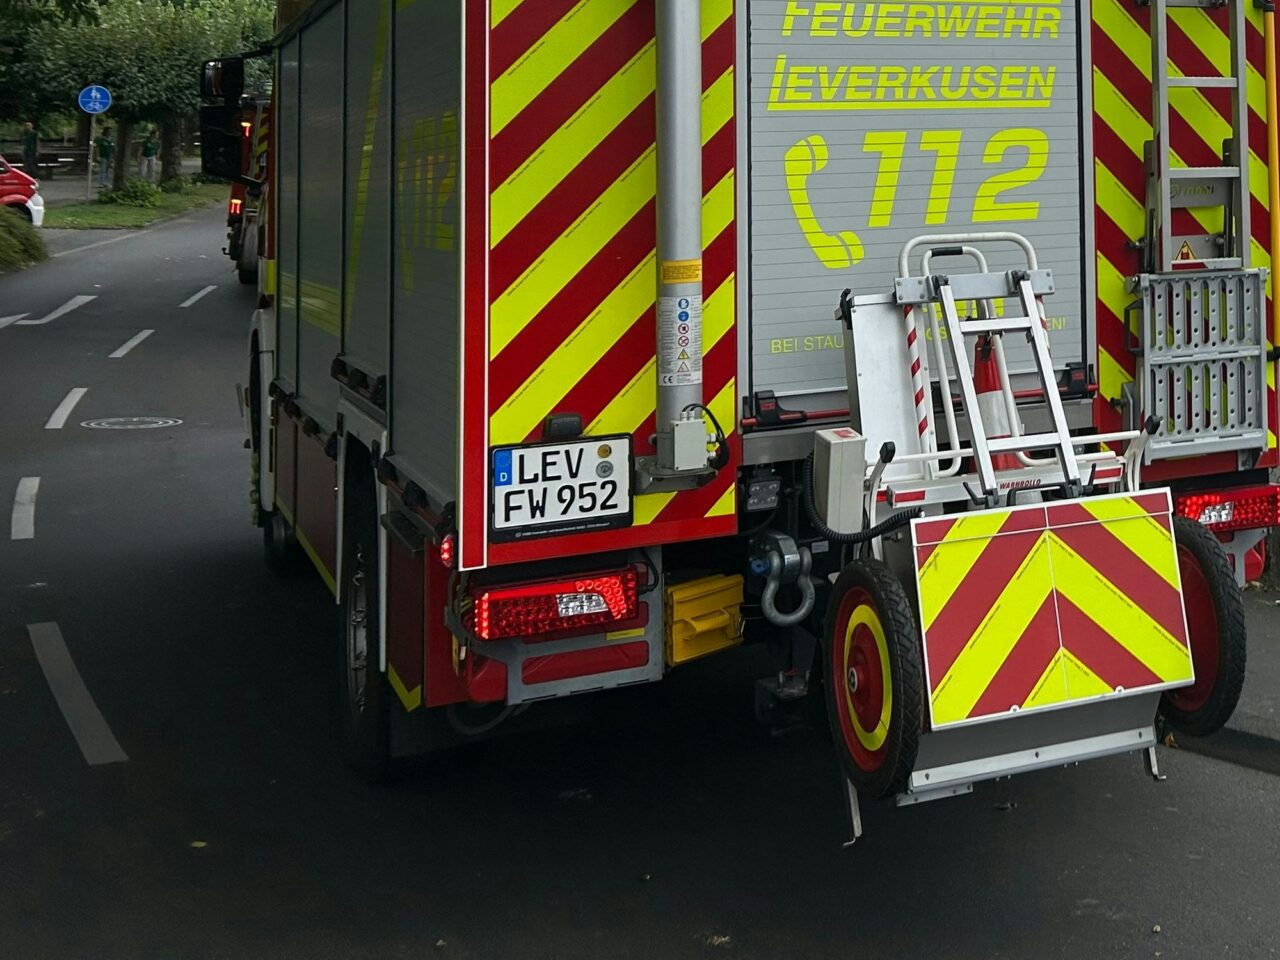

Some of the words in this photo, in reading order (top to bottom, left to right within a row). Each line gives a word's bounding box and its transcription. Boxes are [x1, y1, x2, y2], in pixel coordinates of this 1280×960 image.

[767, 54, 1057, 111] LEVERKUSEN
[862, 127, 1049, 229] 112
[770, 337, 798, 355] BEI
[803, 333, 844, 352] STAU
[500, 472, 508, 482] D
[518, 447, 585, 485] LEV
[503, 486, 548, 523] FW
[556, 479, 618, 516] 952
